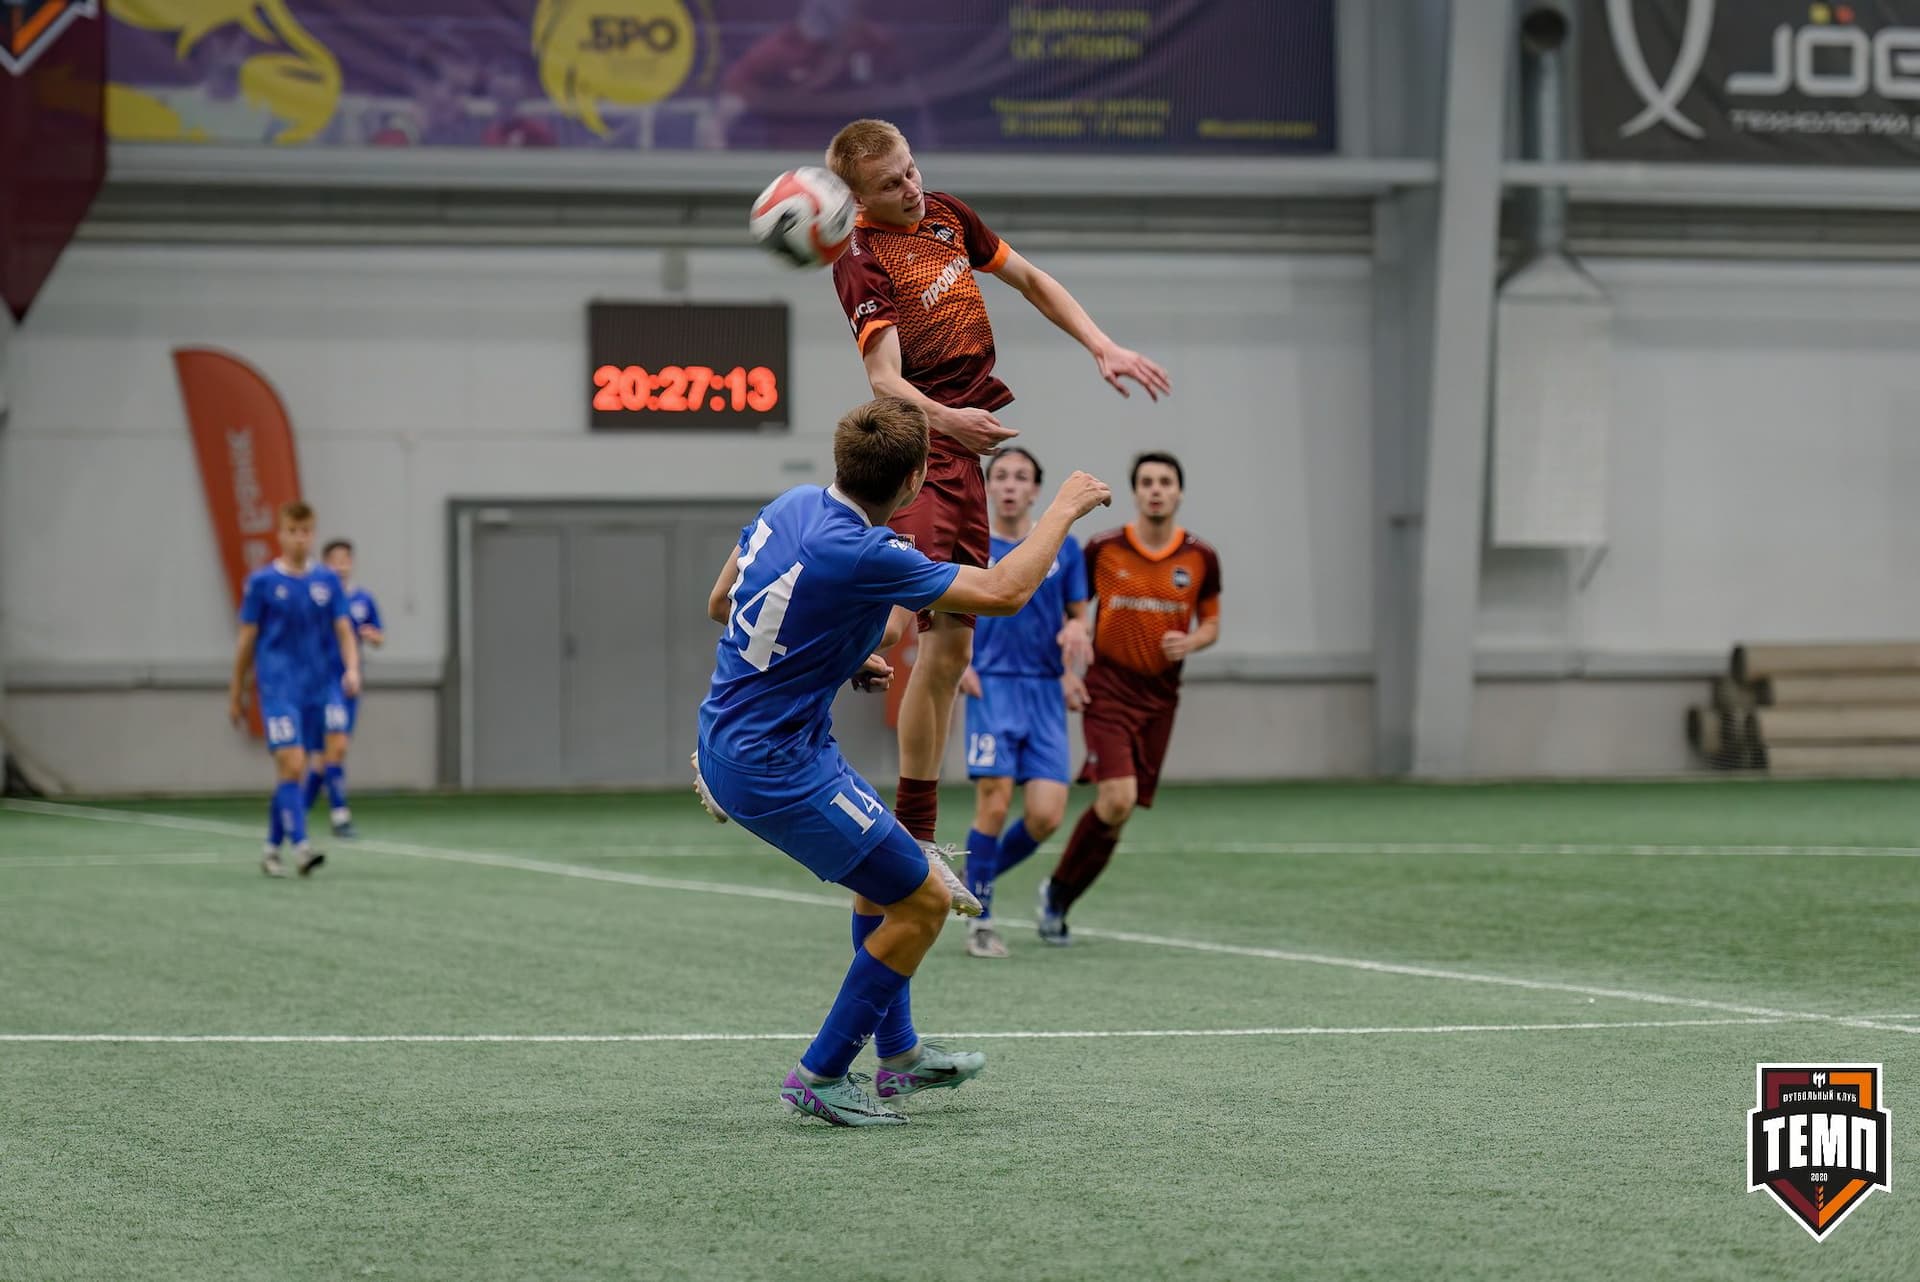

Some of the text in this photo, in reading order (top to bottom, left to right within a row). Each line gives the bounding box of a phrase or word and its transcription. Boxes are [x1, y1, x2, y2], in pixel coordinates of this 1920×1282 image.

[593, 365, 778, 412] 20:27:13
[728, 518, 805, 672] 14
[968, 733, 996, 767] 12
[829, 777, 884, 835] 14
